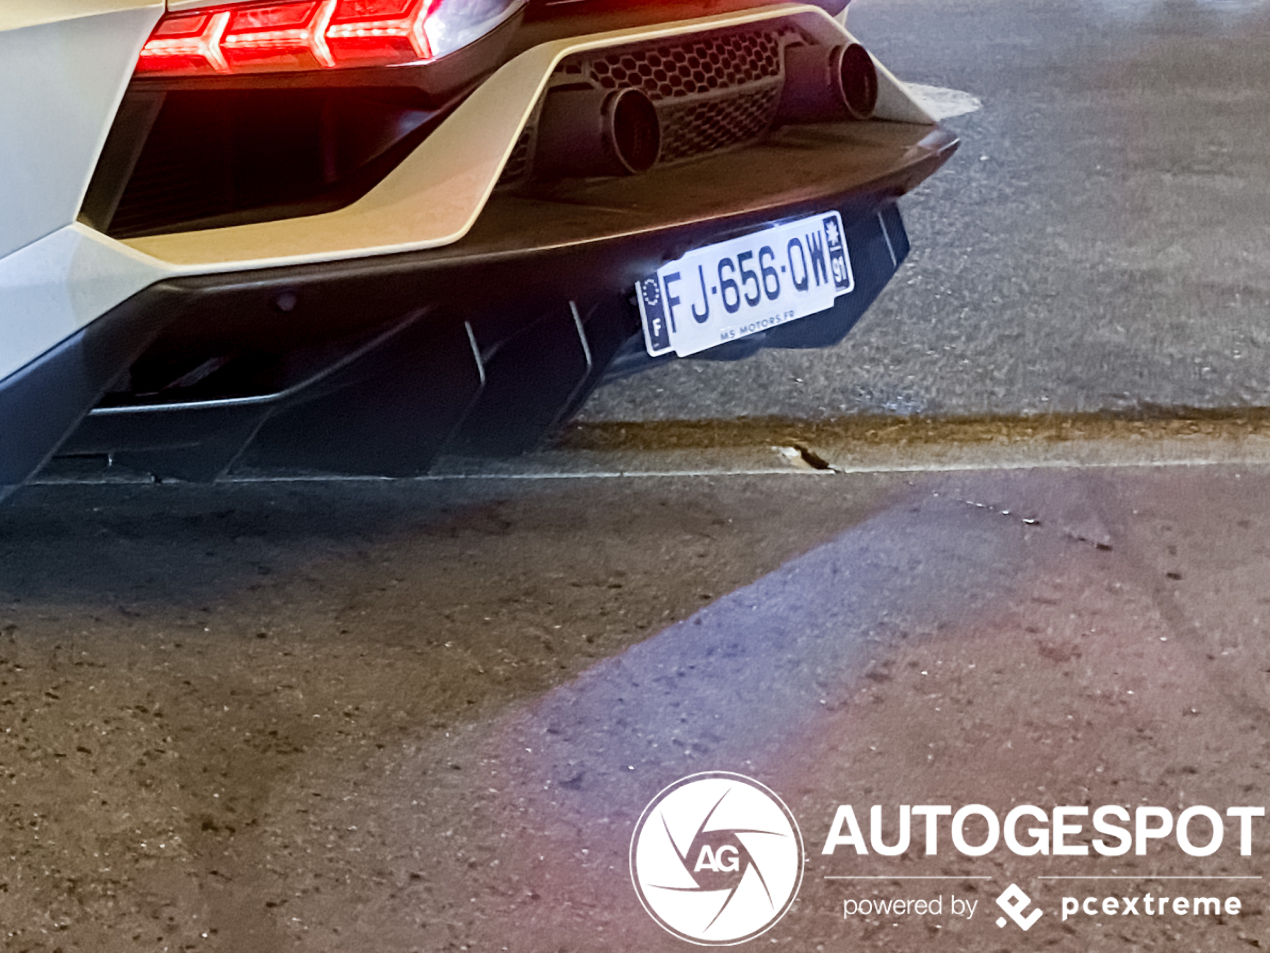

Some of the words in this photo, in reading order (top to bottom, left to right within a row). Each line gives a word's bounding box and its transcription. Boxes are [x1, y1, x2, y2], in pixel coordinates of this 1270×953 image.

[833, 255, 847, 283] 91
[652, 317, 661, 337] F
[720, 329, 735, 341] MS
